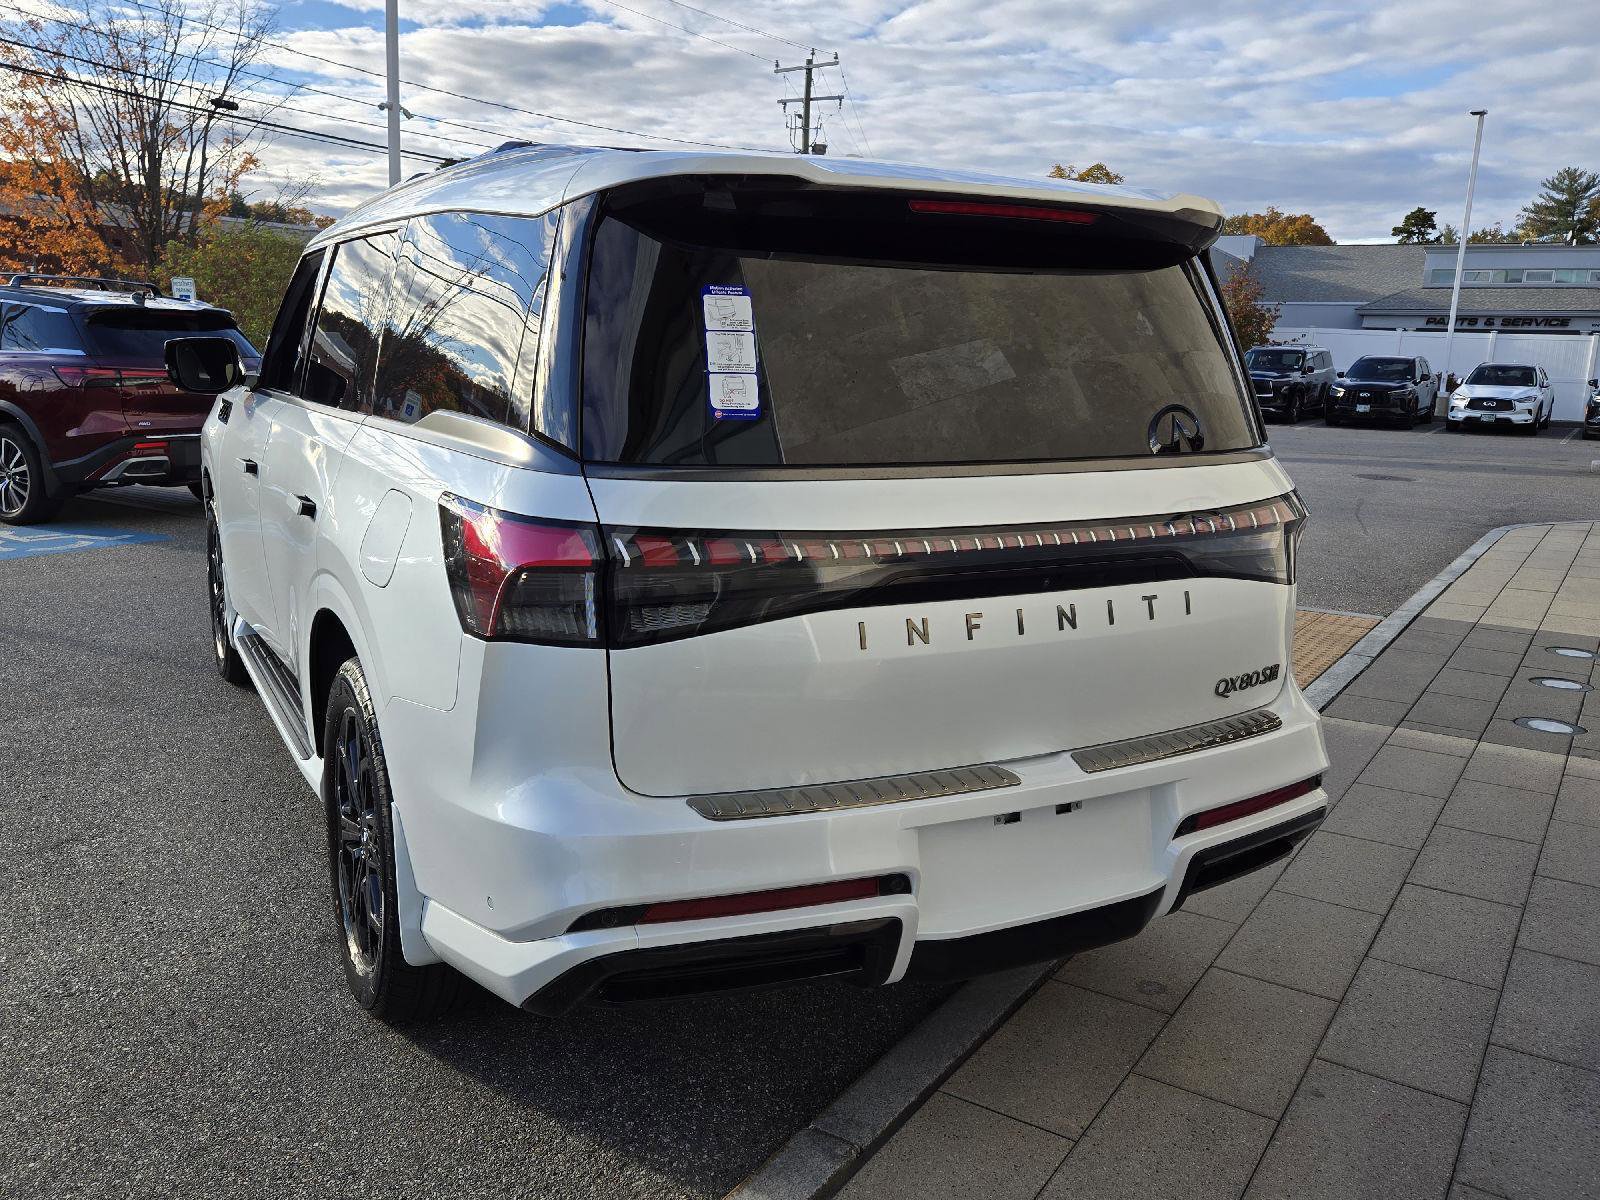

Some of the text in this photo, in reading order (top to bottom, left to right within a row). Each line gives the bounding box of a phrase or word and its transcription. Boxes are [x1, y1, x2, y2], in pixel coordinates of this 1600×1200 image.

[1426, 317, 1571, 327] PATS & SERVICE
[858, 590, 1191, 650] INFINITI
